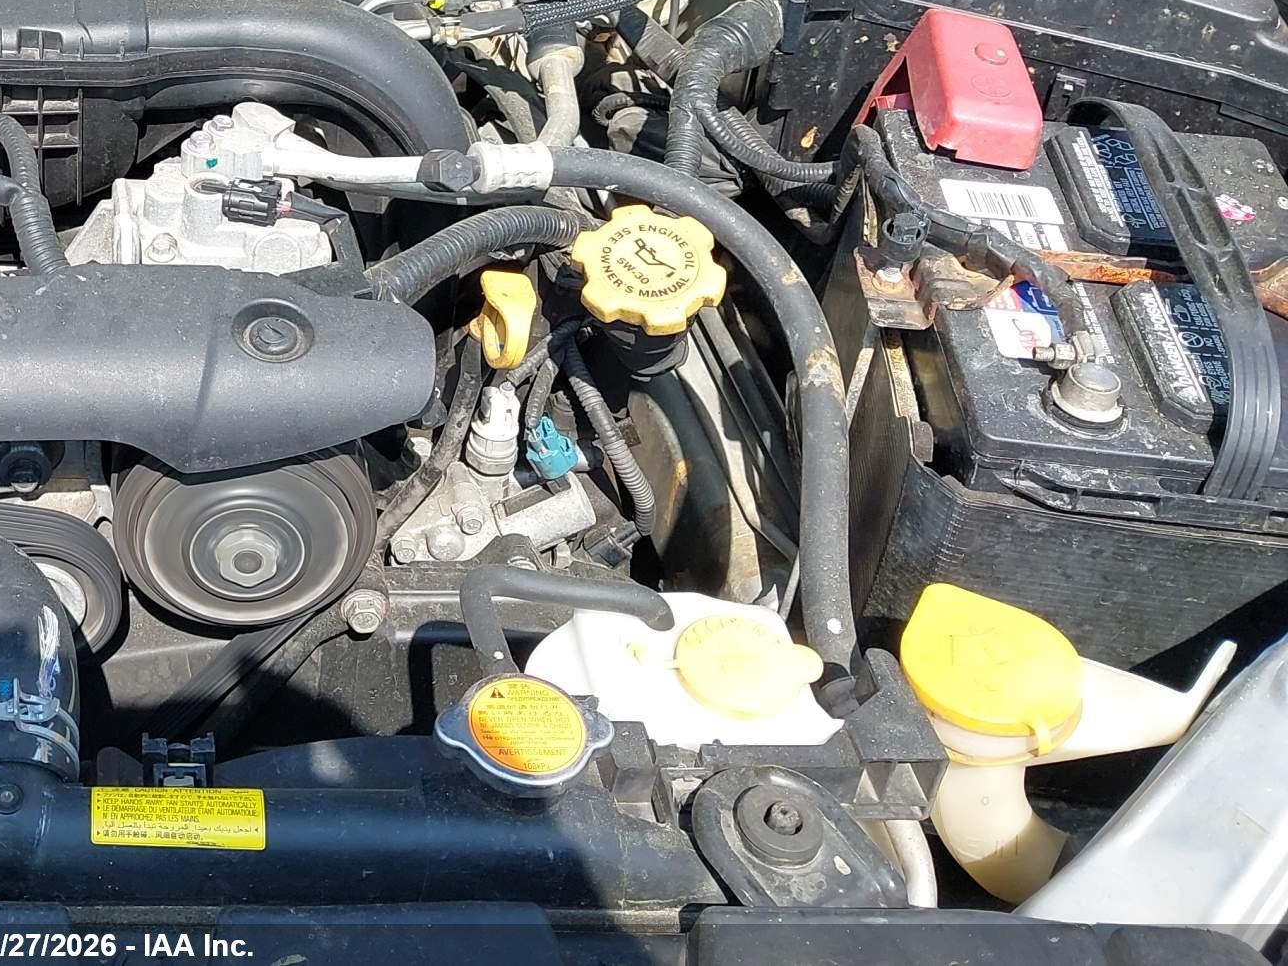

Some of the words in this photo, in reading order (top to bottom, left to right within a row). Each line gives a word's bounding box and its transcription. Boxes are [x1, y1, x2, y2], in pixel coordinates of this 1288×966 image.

[608, 228, 631, 244] SEE
[639, 224, 688, 248] ENGINE
[685, 252, 695, 269] OIL
[601, 246, 634, 294] OWNER'S
[639, 277, 690, 298] MANUAL
[1140, 293, 1168, 331] POISON
[1204, 337, 1215, 346] NO
[1162, 341, 1191, 389] DANGER
